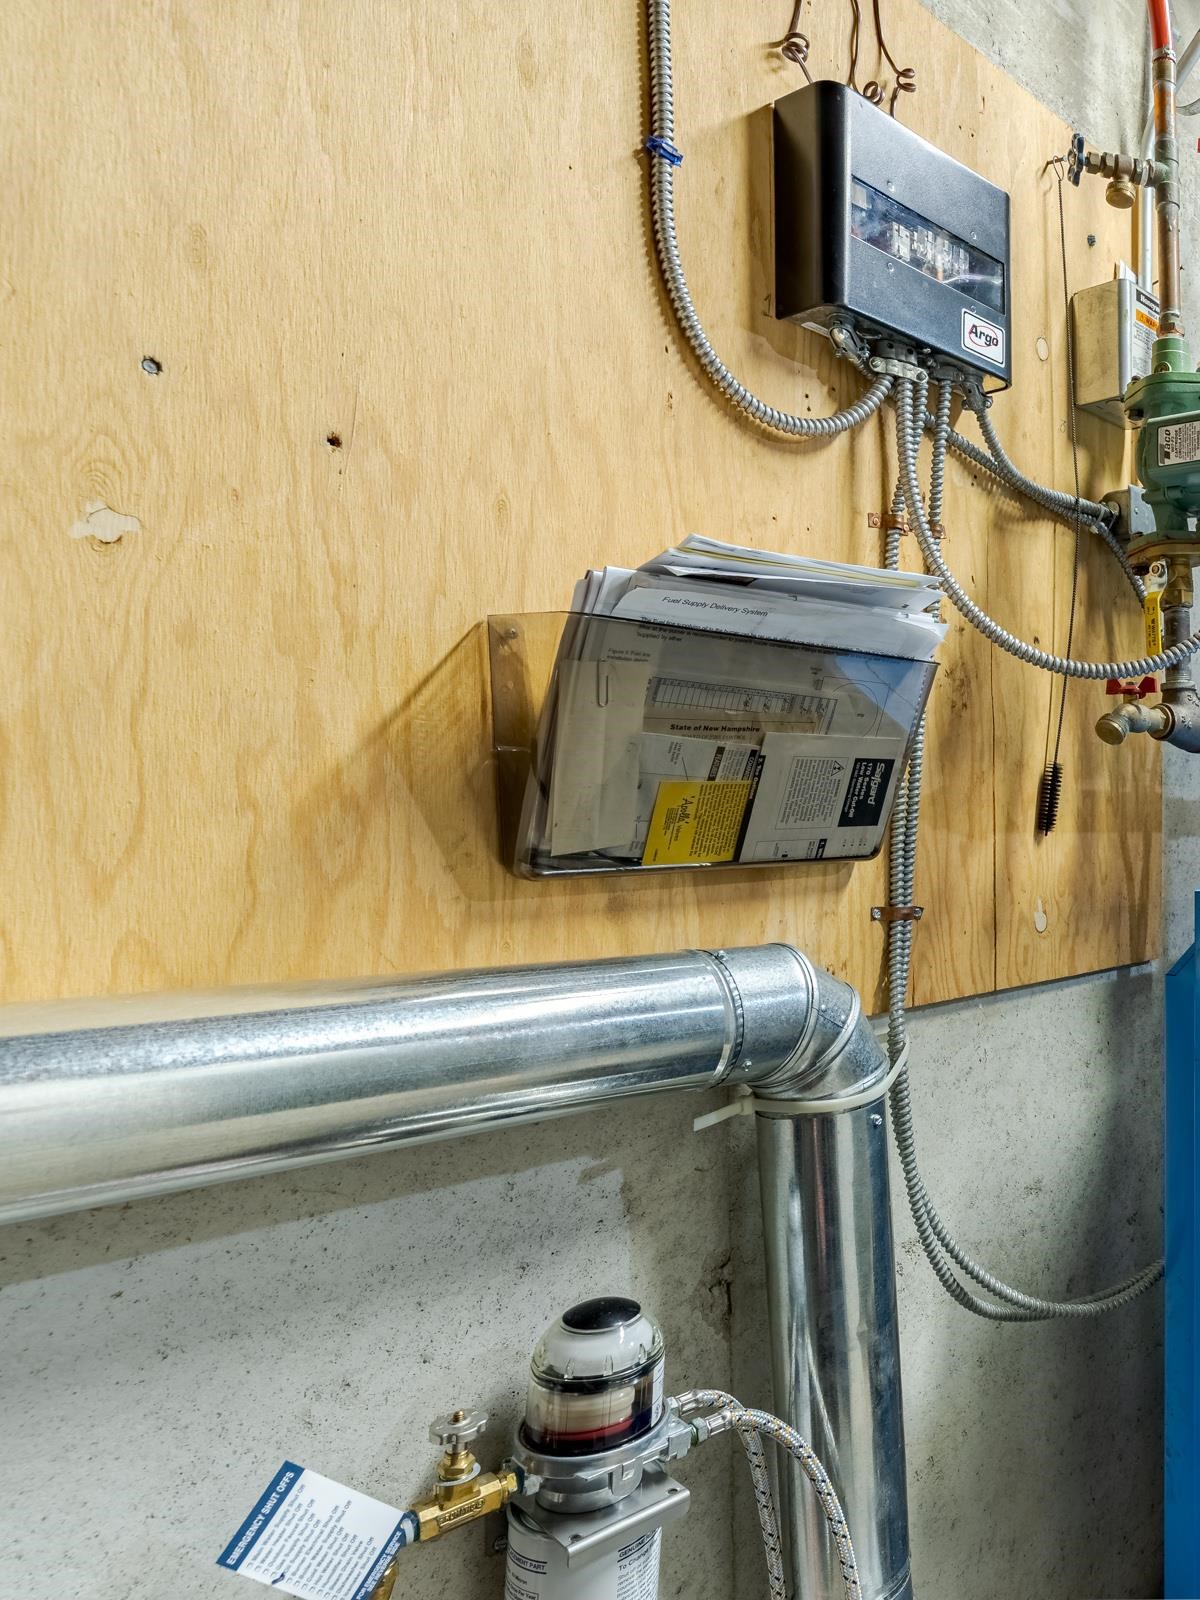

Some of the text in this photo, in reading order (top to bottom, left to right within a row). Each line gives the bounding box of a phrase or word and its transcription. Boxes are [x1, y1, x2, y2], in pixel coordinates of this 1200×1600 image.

[969, 324, 999, 347] Argo
[662, 596, 769, 618] Fuel Supply Delivery System
[670, 724, 691, 732] State
[721, 725, 761, 733] Hampshire
[859, 762, 867, 776] Low
[854, 776, 864, 795] Water
[287, 1493, 300, 1508] Shut
[297, 1483, 306, 1494] Off
[226, 1470, 295, 1566] EMERGENCY SHUT OFFS
[285, 1513, 297, 1527] Shut
[294, 1502, 303, 1513] Off
[297, 1508, 309, 1523] Shut
[306, 1498, 316, 1509] Off
[322, 1514, 334, 1529] Shut
[331, 1504, 340, 1515] Off
[322, 1524, 338, 1544] Supply
[335, 1510, 346, 1524] Shut
[343, 1500, 352, 1510] Off
[284, 1537, 301, 1558] Supply
[298, 1522, 310, 1537] Shut
[307, 1513, 316, 1522] Off
[289, 1543, 307, 1564] Supply
[303, 1529, 315, 1543] Shut
[313, 1519, 321, 1529] Off
[327, 1536, 338, 1551] Shut
[336, 1526, 345, 1536] Off
[332, 1543, 343, 1556] Shut
[341, 1532, 350, 1543] Off
[341, 1544, 352, 1558] Shut
[349, 1534, 358, 1544] Off
[357, 1546, 369, 1560] Shut
[366, 1536, 375, 1546] Off
[360, 1557, 371, 1571] Shut
[369, 1546, 378, 1556] Off
[363, 1554, 389, 1588] EMERGENCY
[384, 1531, 403, 1555] SERVICE
[619, 1538, 646, 1558] GENUINE
[628, 1547, 649, 1566] Change
[529, 1562, 545, 1571] PART
